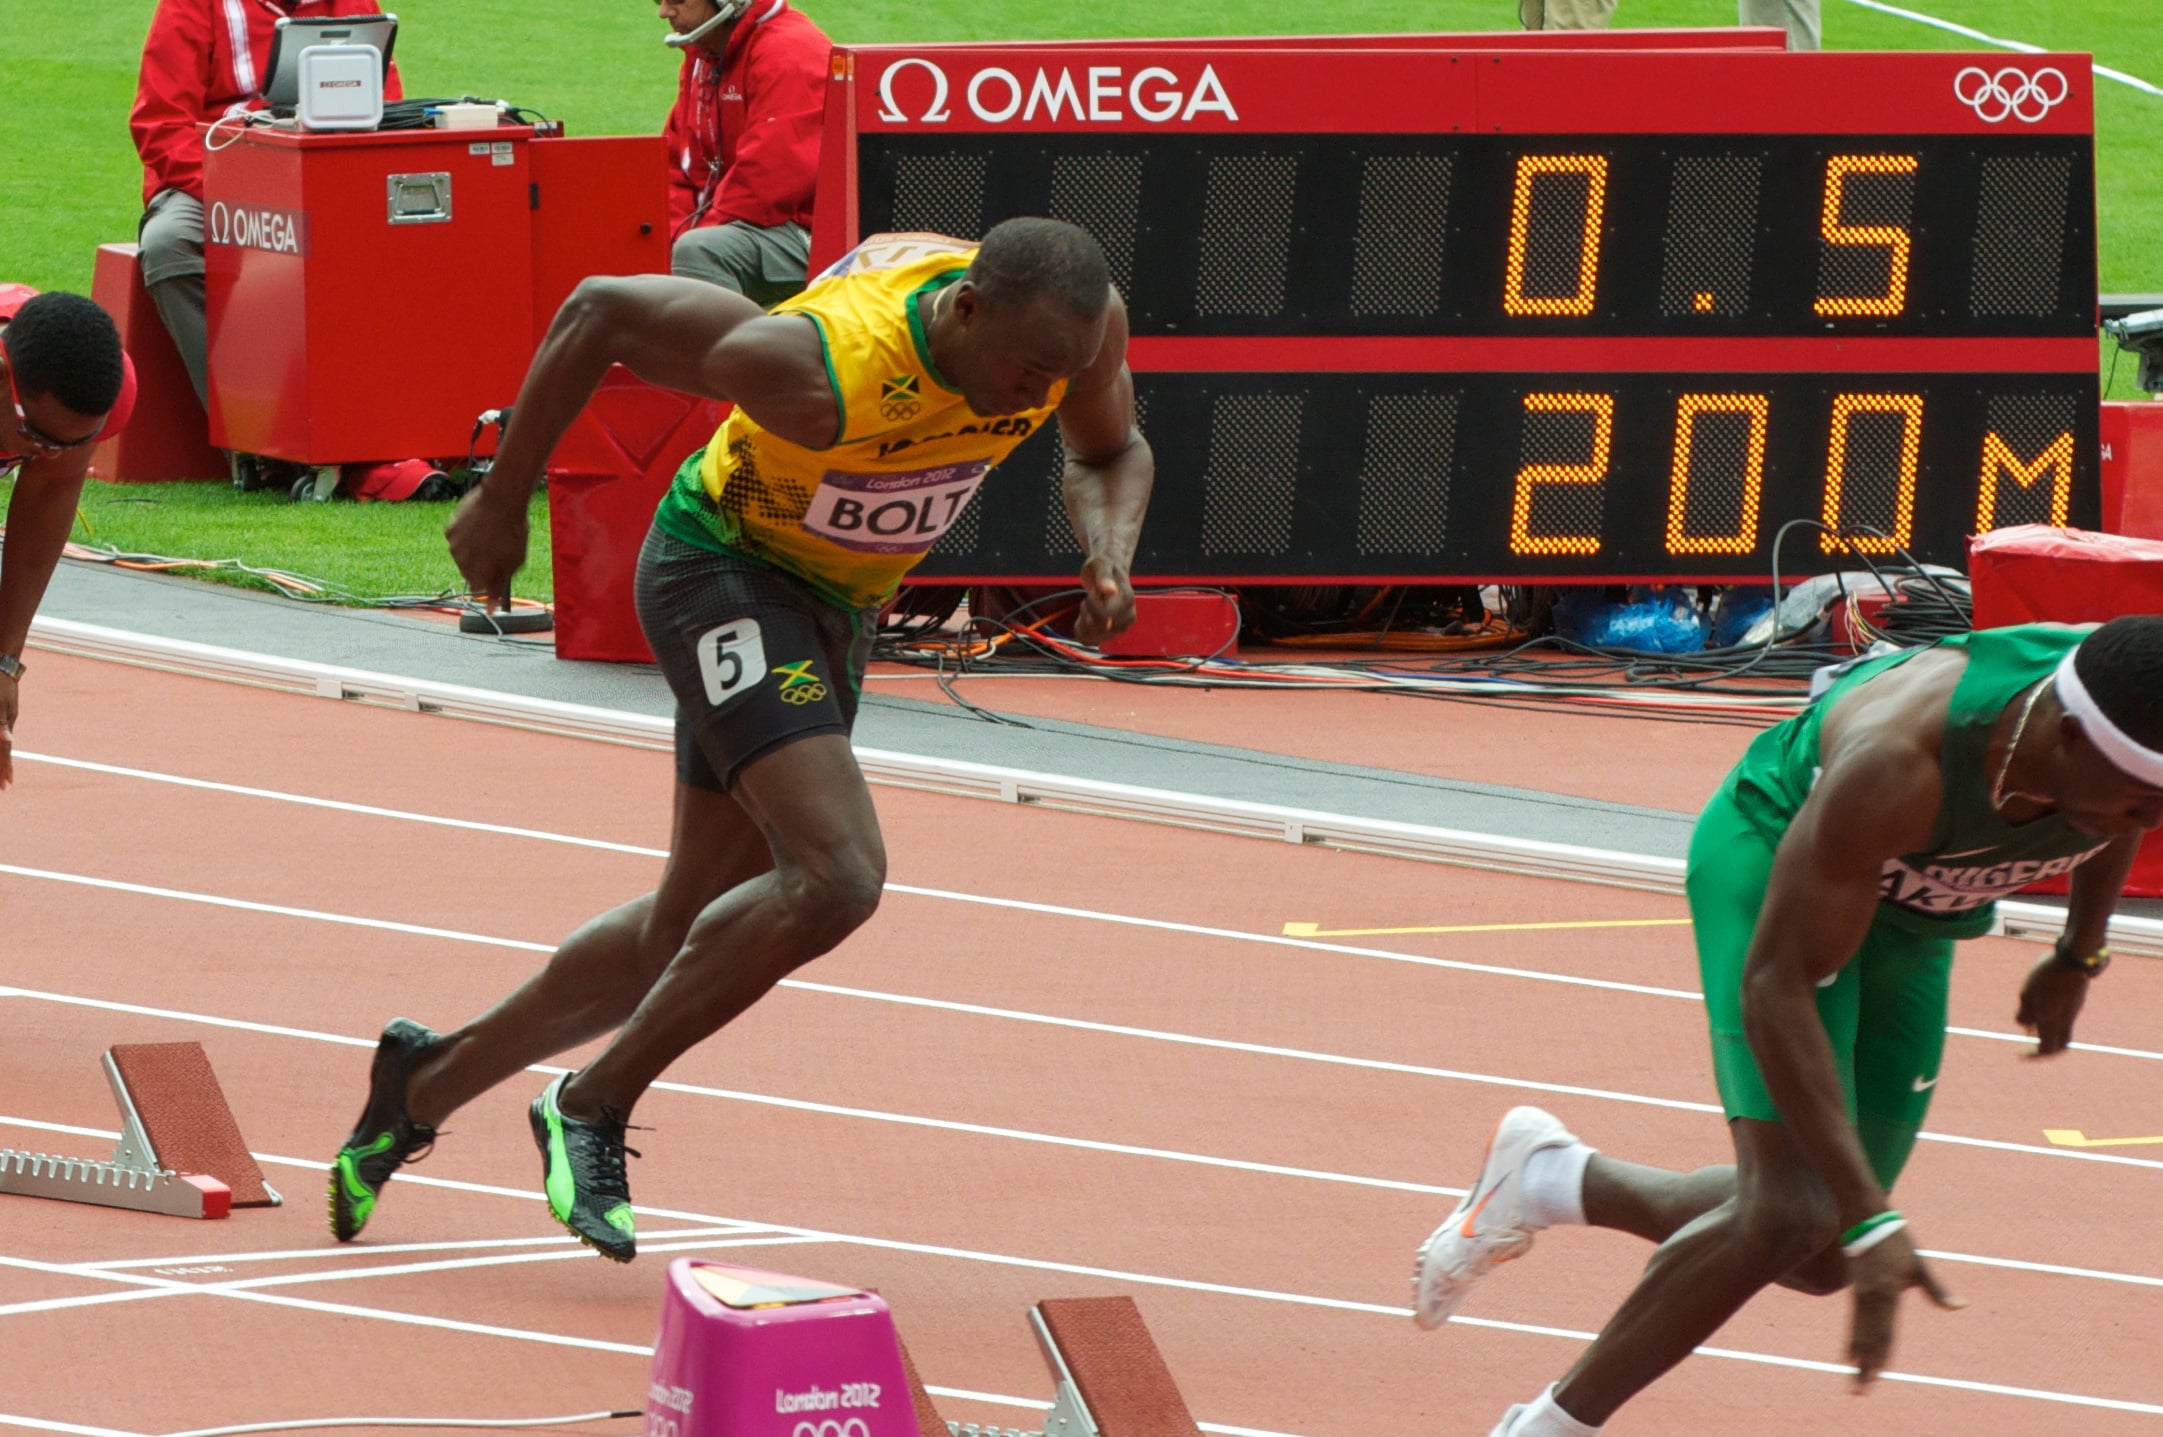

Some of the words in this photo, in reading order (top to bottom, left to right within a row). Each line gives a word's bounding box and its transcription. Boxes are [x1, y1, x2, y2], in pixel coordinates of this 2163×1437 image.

[967, 64, 1239, 122] OMEGA
[233, 208, 299, 254] OMEGA
[865, 475, 922, 490] London
[922, 467, 958, 484] 2012
[828, 487, 971, 536] BOLT
[716, 629, 743, 691] 5
[775, 1384, 840, 1414] London
[839, 1382, 882, 1408] 2012
